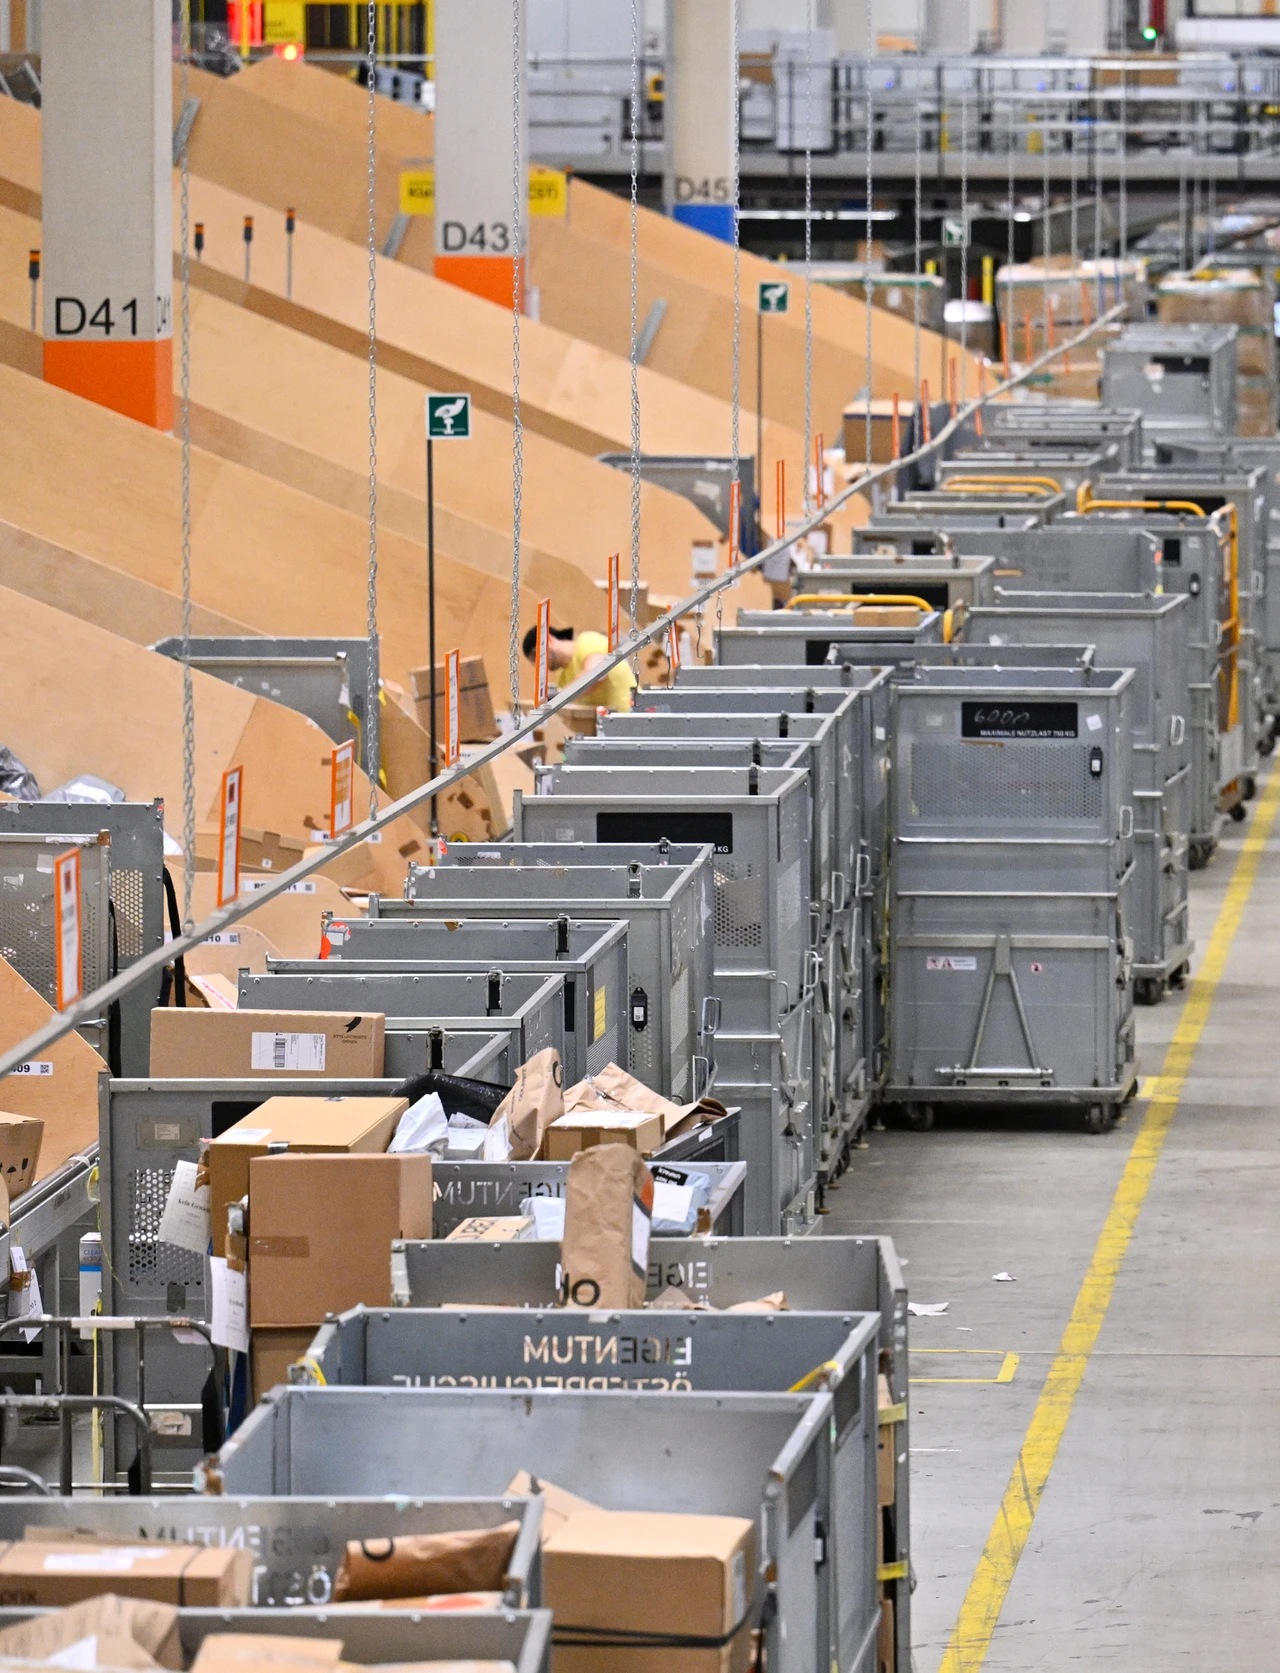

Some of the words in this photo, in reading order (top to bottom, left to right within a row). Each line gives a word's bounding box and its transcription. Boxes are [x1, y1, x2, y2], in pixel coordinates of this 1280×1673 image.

[675, 177, 729, 202] D45
[443, 221, 509, 251] D43
[55, 297, 137, 336] D41
[717, 845, 729, 853] KG
